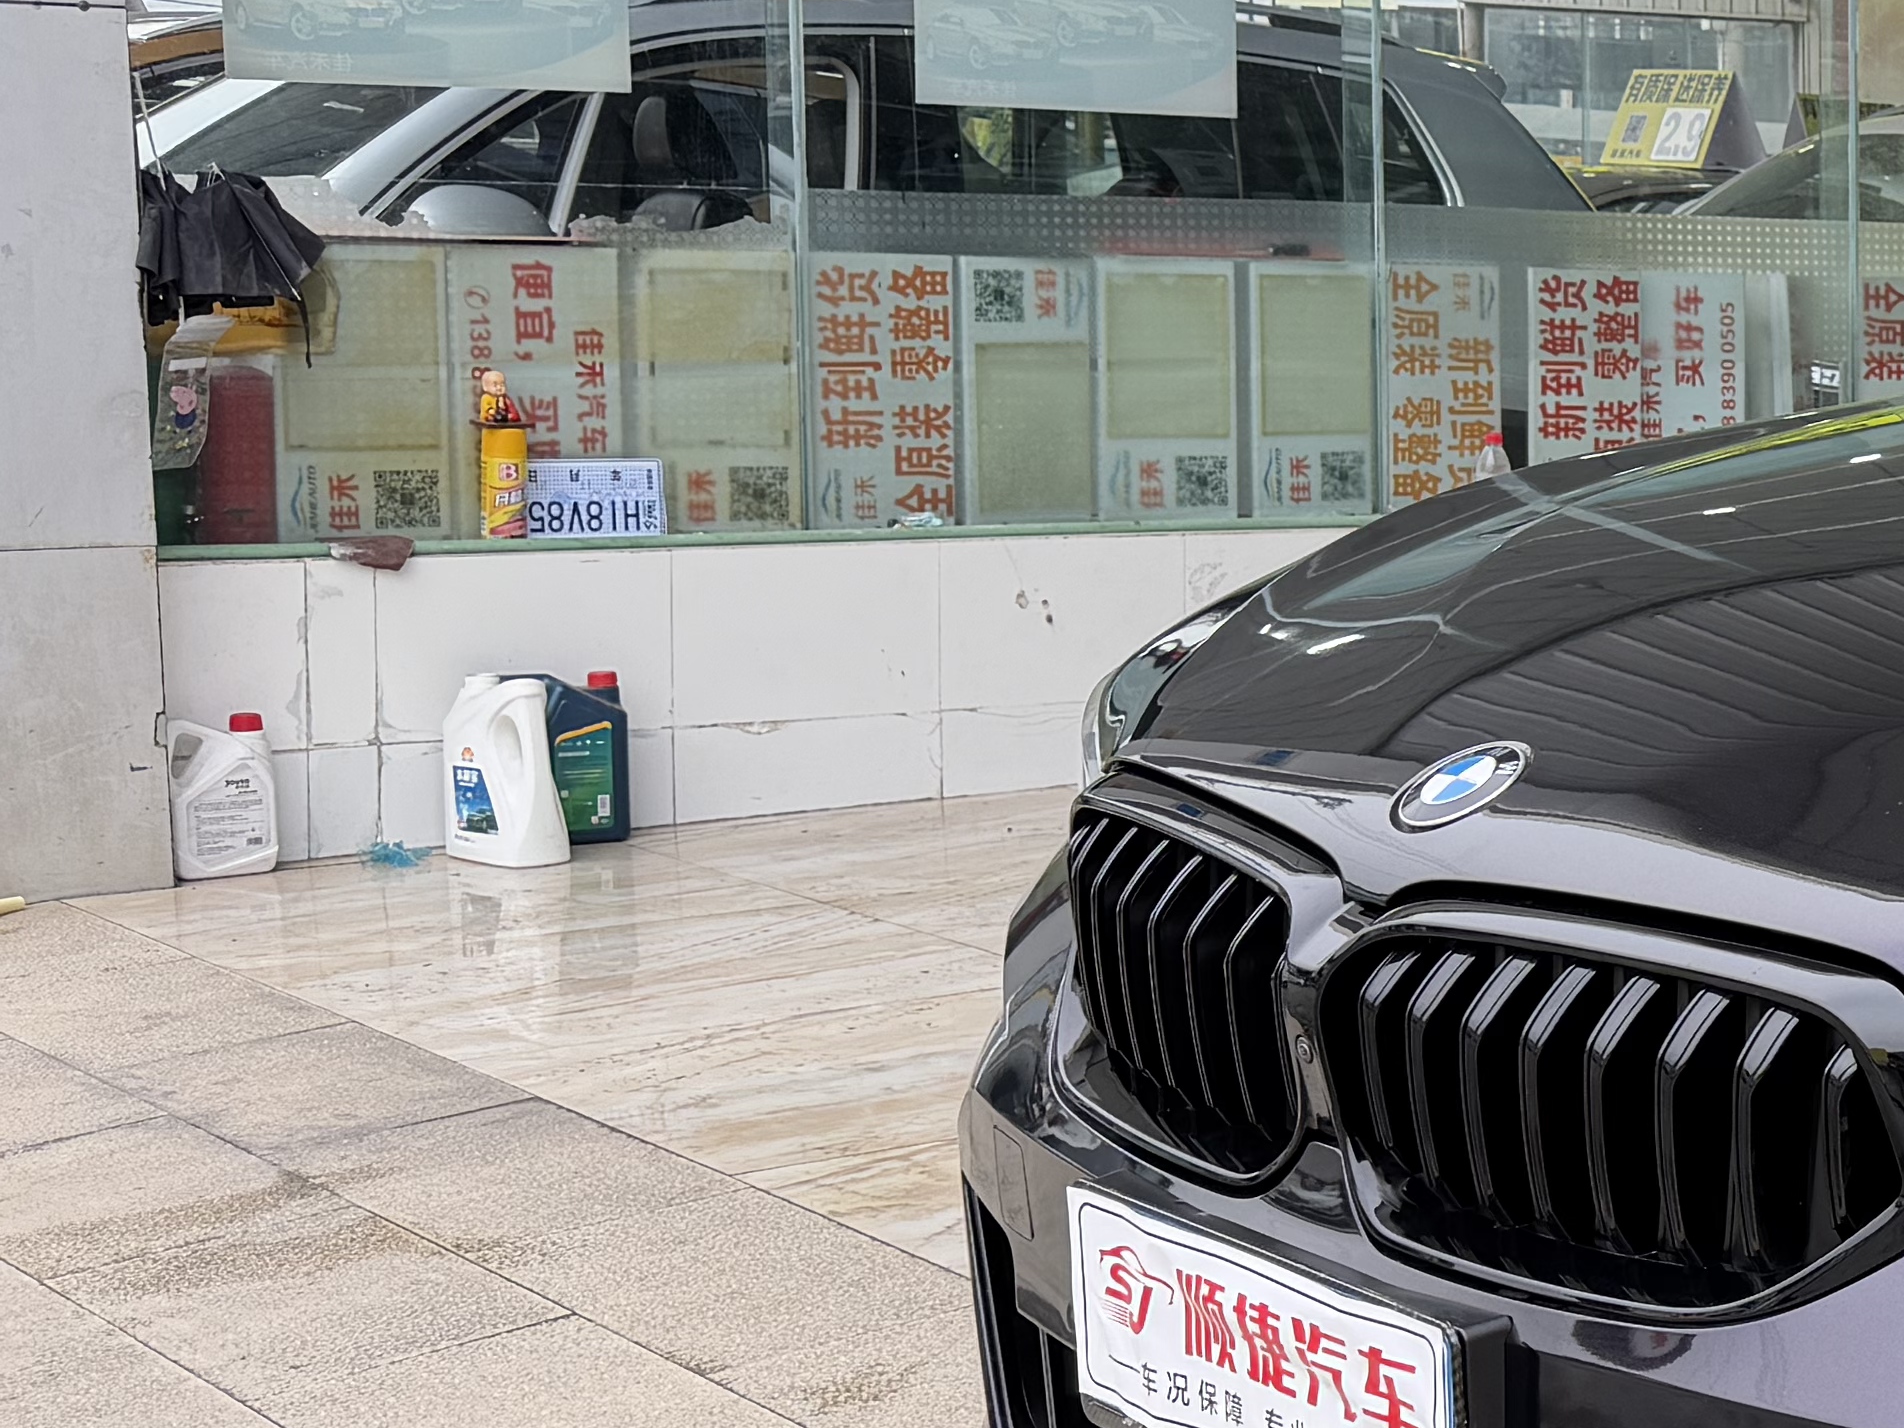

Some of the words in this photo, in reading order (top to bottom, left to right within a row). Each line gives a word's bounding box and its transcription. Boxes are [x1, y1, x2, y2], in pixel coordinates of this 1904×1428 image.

[1625, 72, 1680, 103] 有质保
[1673, 72, 1729, 104] 送保养
[889, 265, 951, 383] 零整备
[1391, 268, 1441, 377] 全原装
[1593, 274, 1641, 381] 零整备
[1719, 302, 1736, 353] 0505
[814, 265, 885, 450] 新到鲜货
[1538, 274, 1589, 442] 新到鲜货
[1720, 359, 1738, 413] 8390
[328, 474, 361, 533] 佳禾
[1289, 454, 1313, 504] 佳禾
[1140, 1362, 1245, 1427] 车况保障
